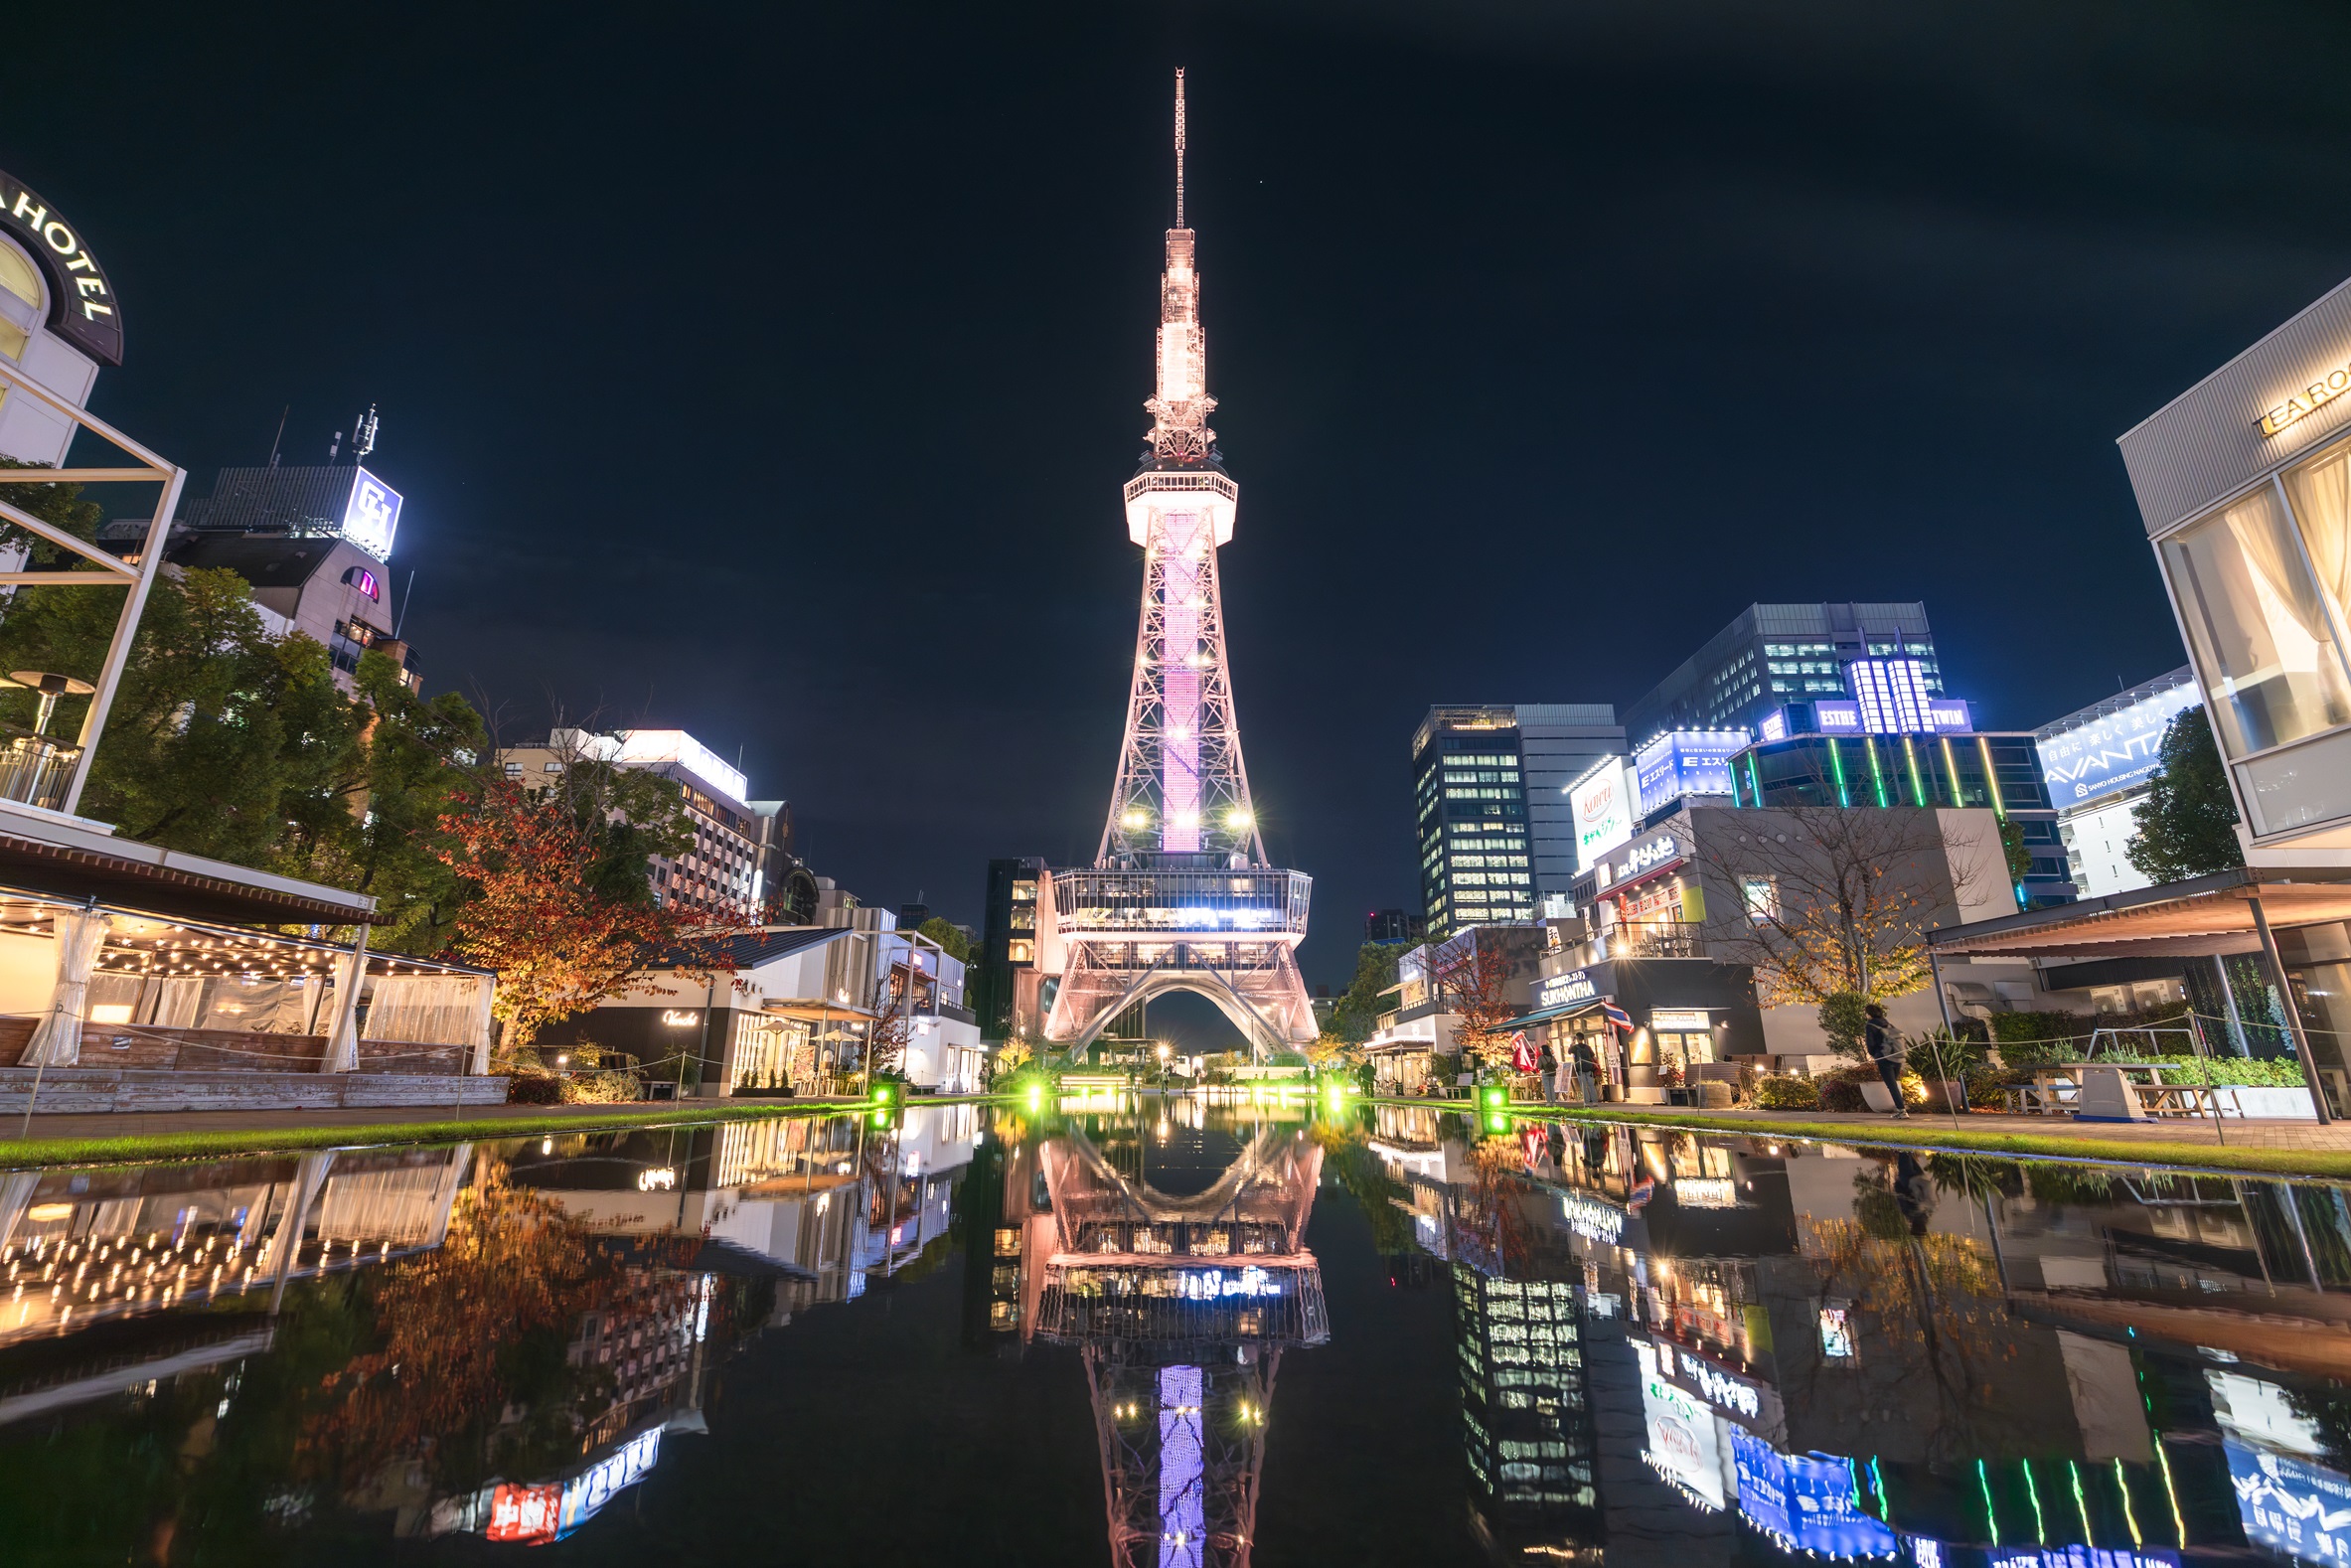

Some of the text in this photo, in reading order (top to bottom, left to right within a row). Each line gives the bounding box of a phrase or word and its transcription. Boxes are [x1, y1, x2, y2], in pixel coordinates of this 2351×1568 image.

[12, 191, 113, 322] HOTEL
[2252, 363, 2351, 435] TEA RO
[1819, 709, 1963, 726] ESTHE TWIN
[2048, 706, 2168, 763] 自由に 楽しく 美しく
[2108, 771, 2135, 785] HOUSING
[1541, 981, 1595, 1006] SUKHONTHA
[663, 1010, 698, 1025] Venchi
